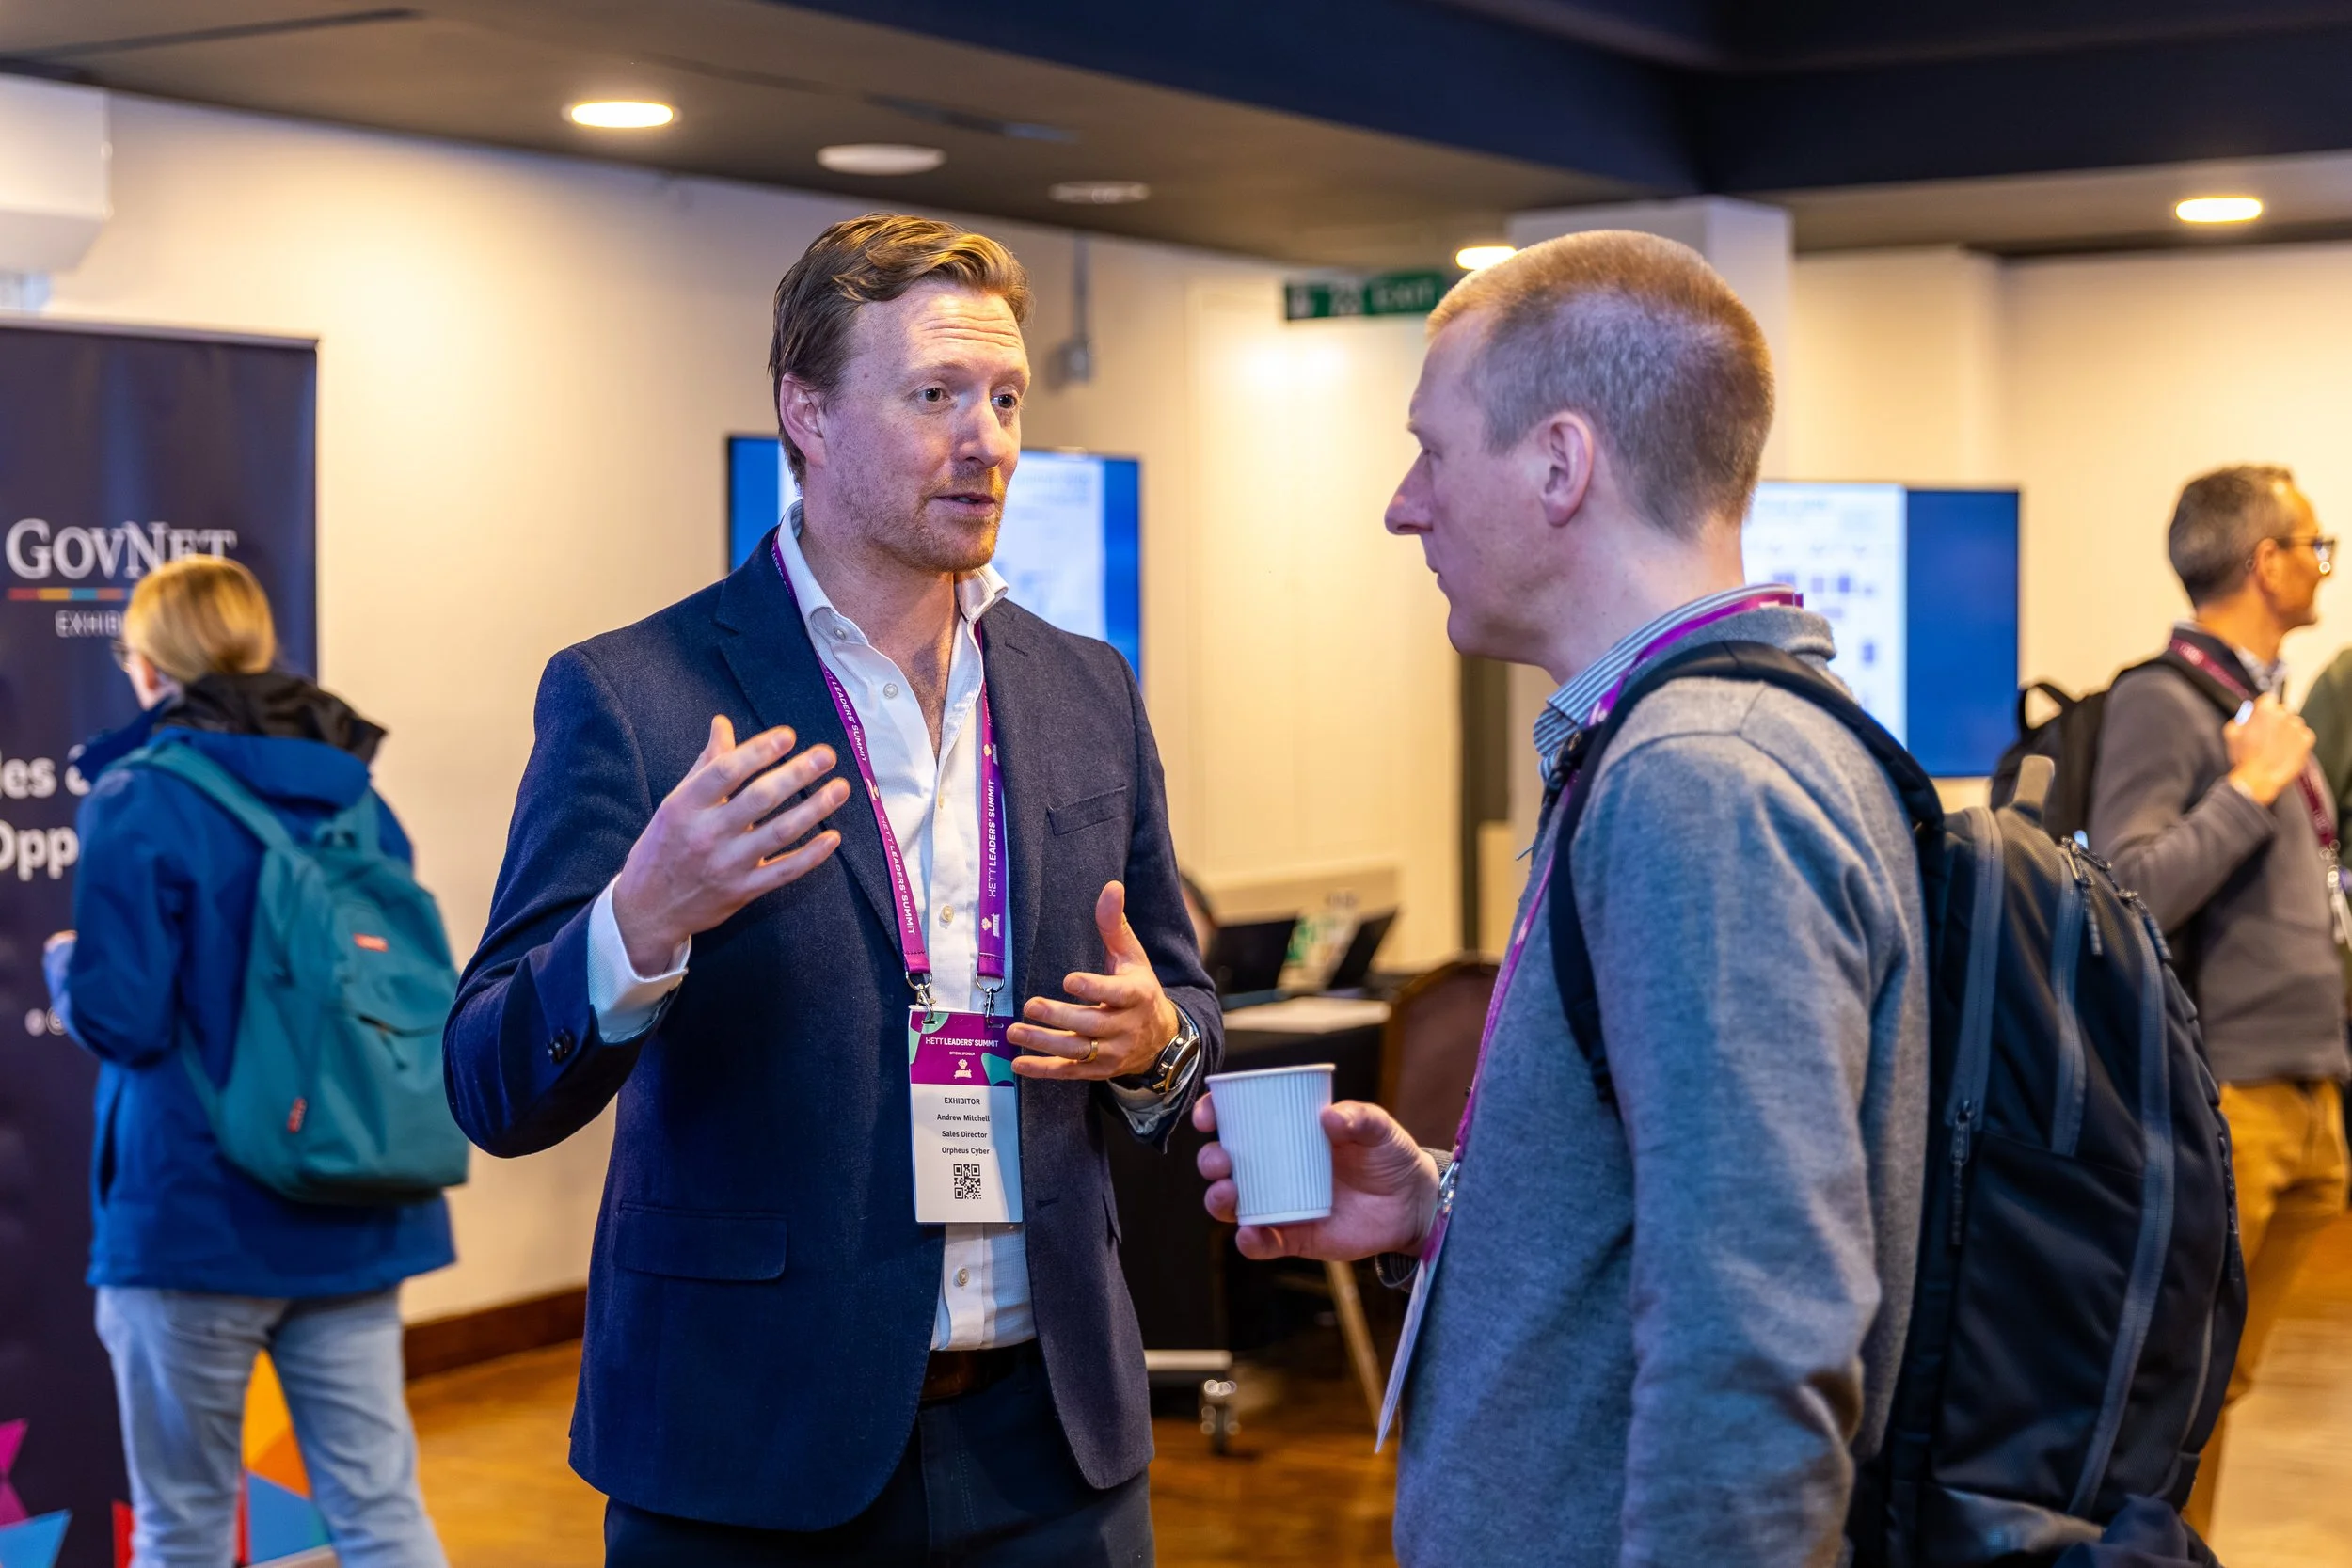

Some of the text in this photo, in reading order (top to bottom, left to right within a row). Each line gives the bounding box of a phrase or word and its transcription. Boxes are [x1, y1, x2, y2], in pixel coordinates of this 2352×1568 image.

[851, 724, 867, 764] SUMMIT
[988, 870, 996, 897] HETT
[901, 894, 915, 935] SUMMIT
[925, 1037, 944, 1045] HETT
[974, 1038, 999, 1047] SUMMIT
[944, 1097, 980, 1105] EXHIBITOR
[937, 1113, 991, 1122] Andrew Mitchell
[941, 1130, 960, 1138] Sales
[941, 1147, 990, 1156] Orpheus Cyber
